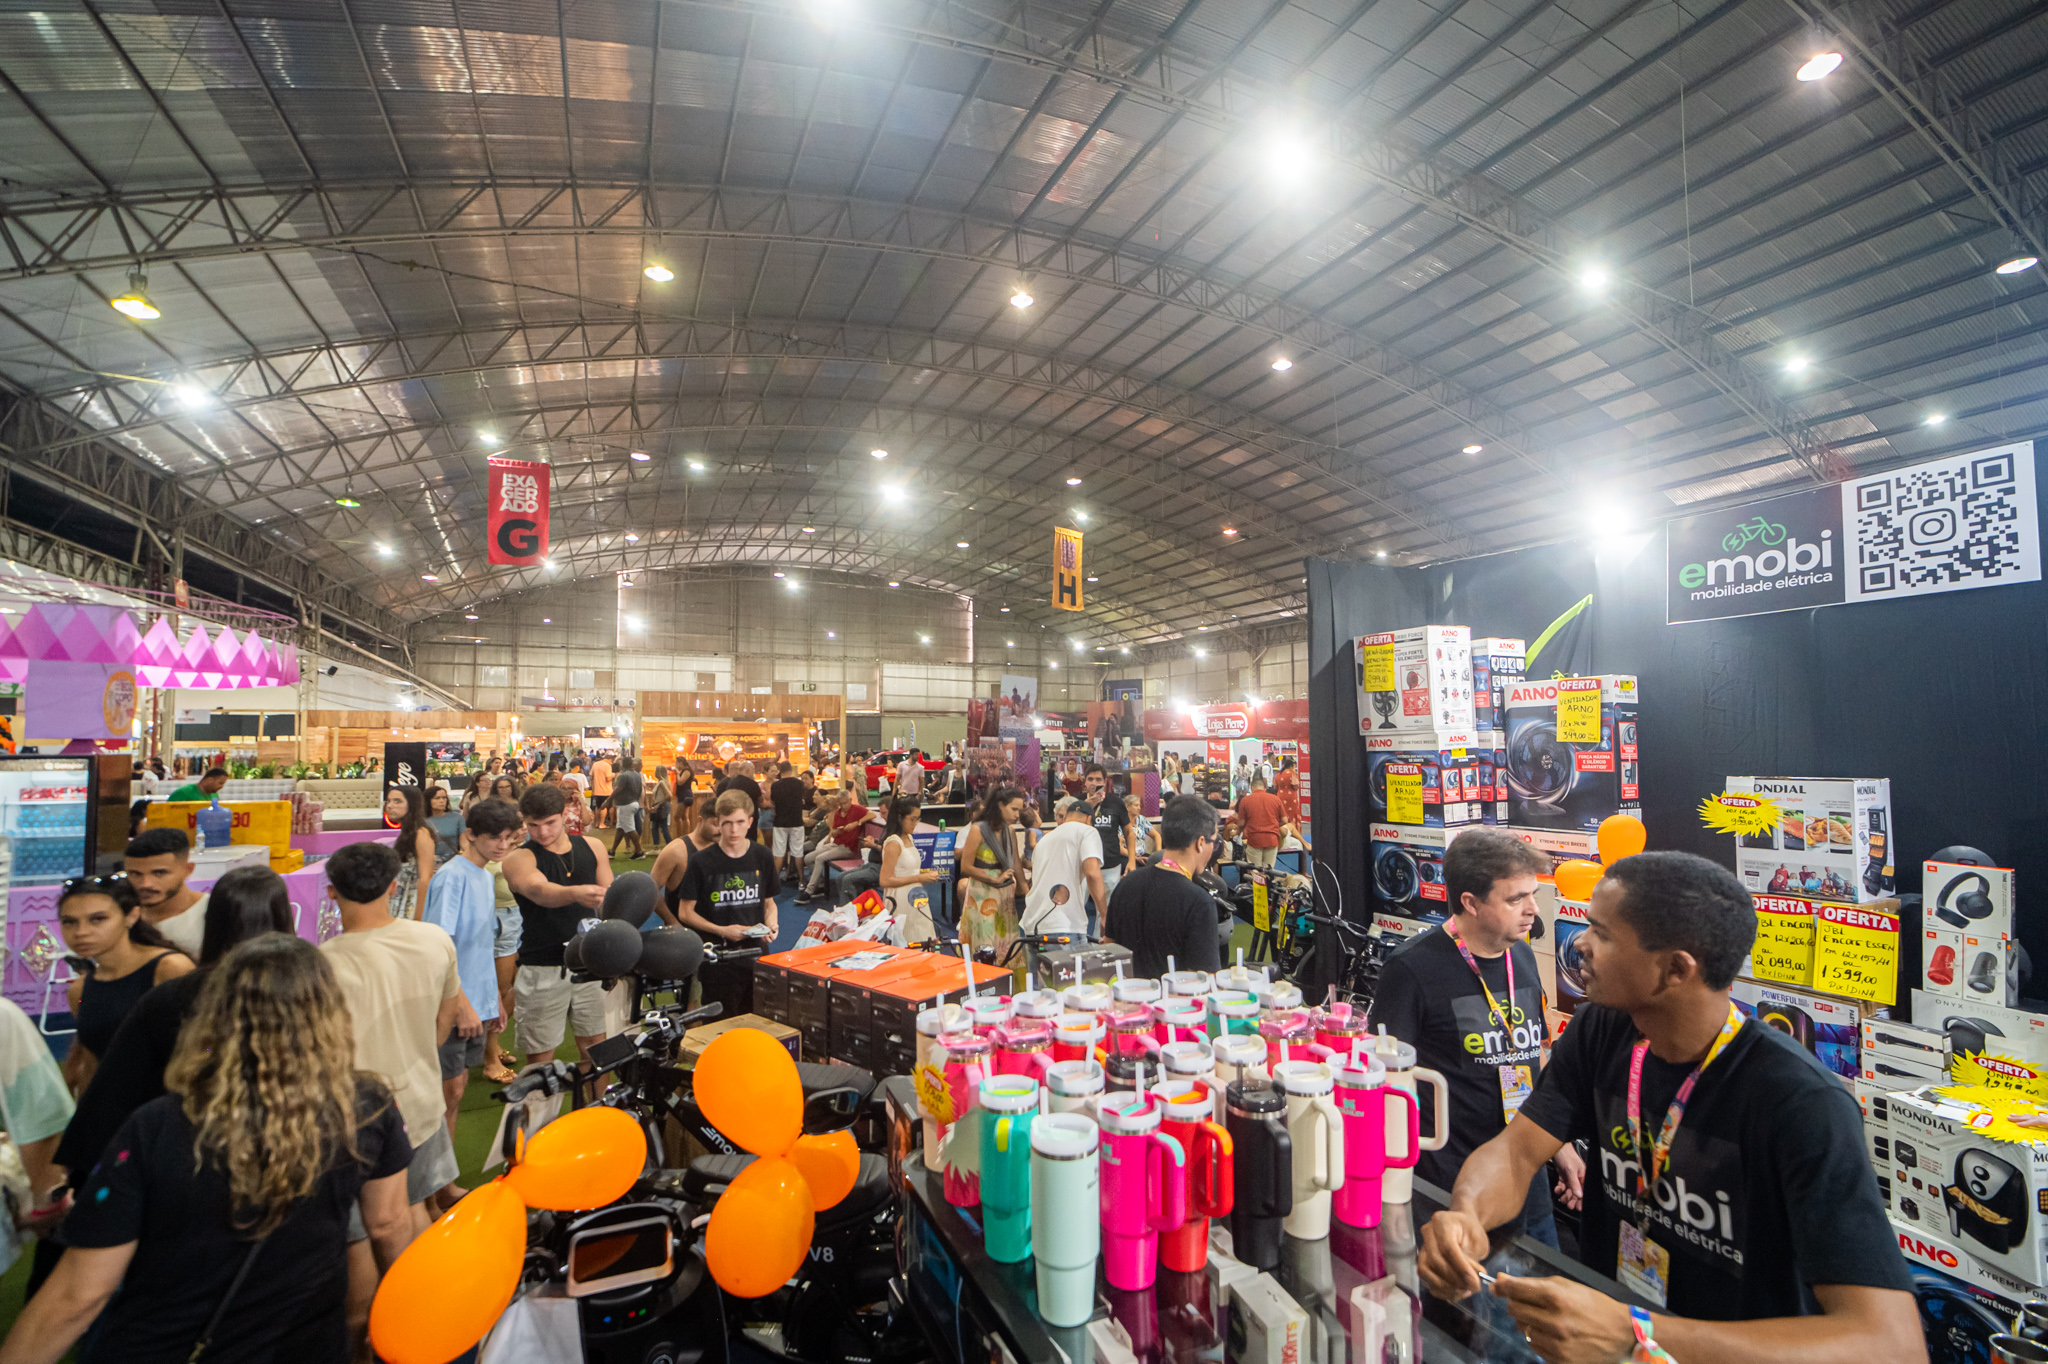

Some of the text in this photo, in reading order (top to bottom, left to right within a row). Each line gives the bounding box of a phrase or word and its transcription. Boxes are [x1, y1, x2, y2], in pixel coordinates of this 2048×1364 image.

[502, 473, 538, 488] EXA
[501, 486, 538, 500] GER
[500, 499, 539, 513] ADO
[497, 518, 539, 557] G
[1679, 529, 1833, 589] emobi
[1059, 572, 1076, 606] H
[1691, 570, 1833, 601] mobilidade elétrica
[1364, 634, 1392, 645] OFERTA
[1560, 680, 1597, 690] OFERTA
[1511, 686, 1558, 701] ARNO
[1567, 705, 1593, 713] ARNO
[1046, 719, 1063, 727] OUTLET
[1208, 717, 1244, 732] Lojas Pierre
[1368, 739, 1393, 748] ARNO
[745, 751, 777, 759] oceria
[1388, 765, 1419, 774] OFERTA
[1395, 787, 1415, 795] ARNO
[1754, 784, 1806, 794] ONDIAL
[1857, 785, 1876, 795] MONDIAL
[1721, 798, 1756, 807] OFERTA
[1374, 829, 1399, 838] ARNO
[710, 884, 759, 902] emobi
[1559, 905, 1588, 919] ARN
[1752, 897, 1808, 914] OFERTA
[1378, 919, 1403, 931] ARNO
[1824, 906, 1893, 930] OFERTA
[1761, 989, 1799, 1005] POWERFUL
[1936, 999, 1963, 1010] ONYX
[1969, 1006, 2009, 1019] STUDIO
[1978, 1058, 2030, 1079] OFERTA
[1891, 1103, 1956, 1136] MONDIAL
[1674, 1223, 1745, 1266] elétrica
[1899, 1233, 1959, 1268] RNO
[810, 1246, 834, 1263] V8
[1977, 1267, 2021, 1292] XTREME
[1976, 1294, 2020, 1317] POTÊNCIA
